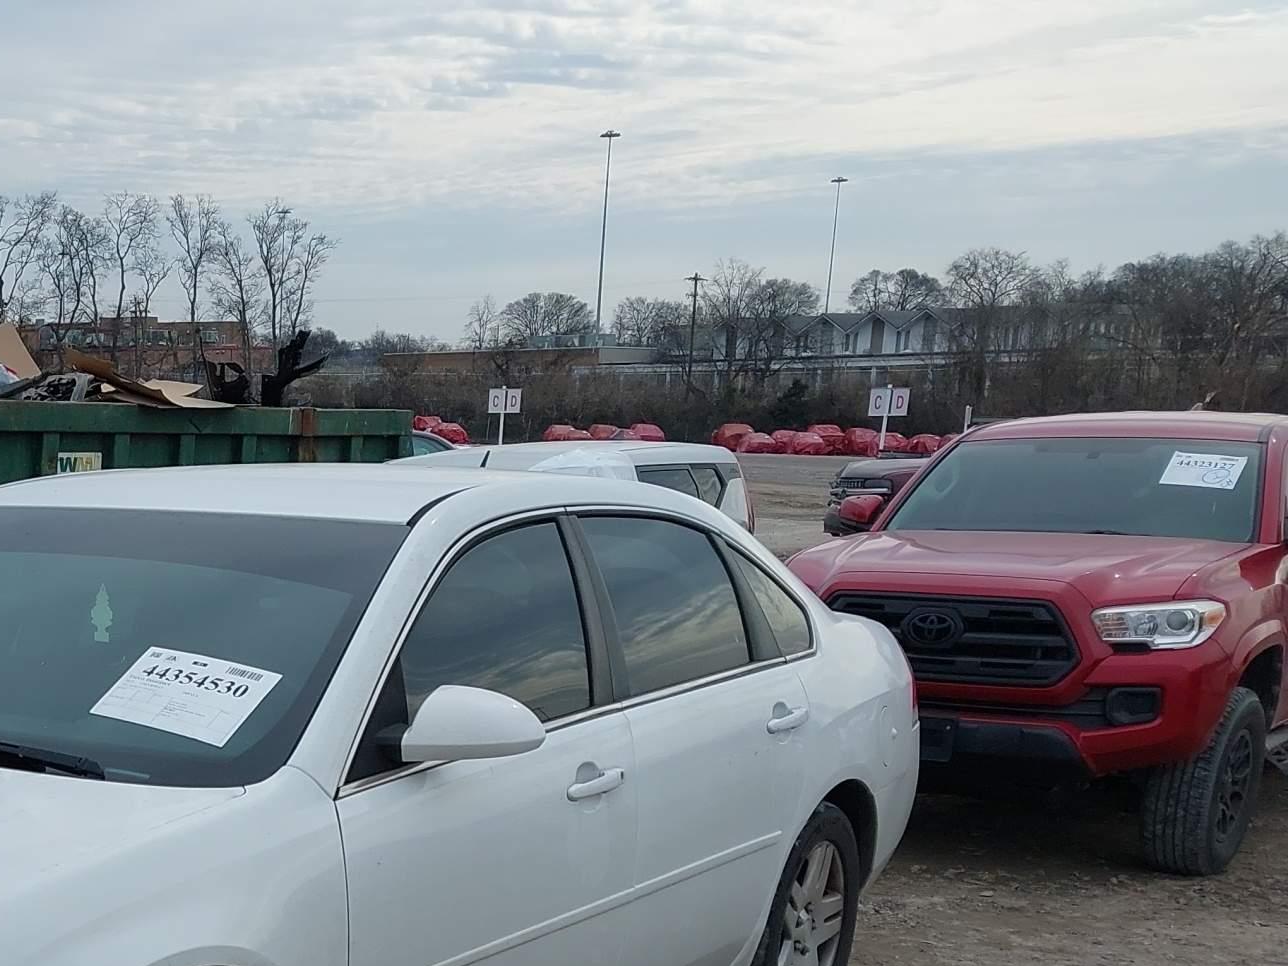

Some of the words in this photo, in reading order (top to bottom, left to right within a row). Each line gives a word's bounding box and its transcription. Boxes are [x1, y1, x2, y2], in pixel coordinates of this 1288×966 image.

[492, 395, 500, 408] C
[510, 395, 517, 408] D
[874, 395, 882, 410] C
[895, 395, 905, 409] D
[142, 664, 250, 698] 44354530
